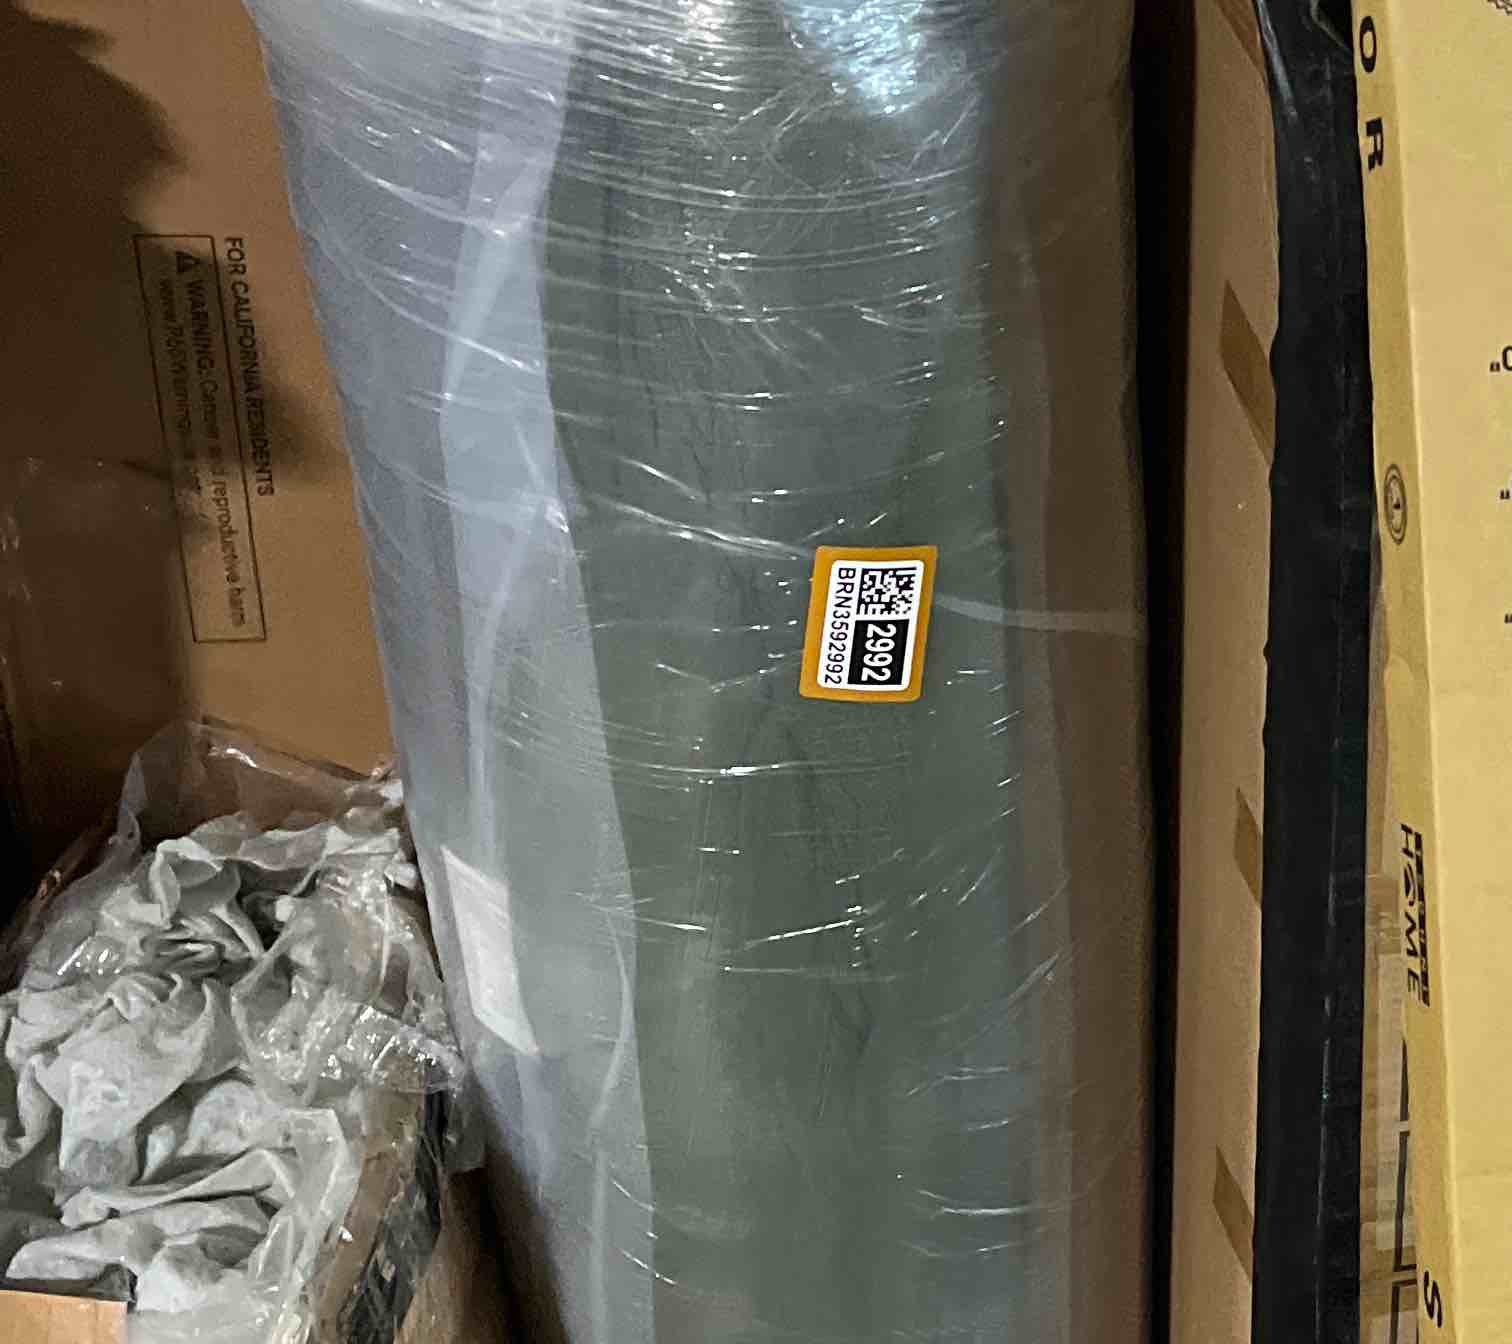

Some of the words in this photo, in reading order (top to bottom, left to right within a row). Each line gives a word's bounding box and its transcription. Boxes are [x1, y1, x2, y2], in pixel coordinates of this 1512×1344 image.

[224, 236, 246, 275] FOR
[231, 280, 259, 397] CALIFORNIA
[186, 279, 210, 374] WARNING:
[211, 479, 240, 585] reproductive
[226, 587, 246, 628] harm
[246, 399, 274, 496] RESIDENTS
[824, 567, 857, 685] BRN3592992
[861, 623, 898, 682] 2992
